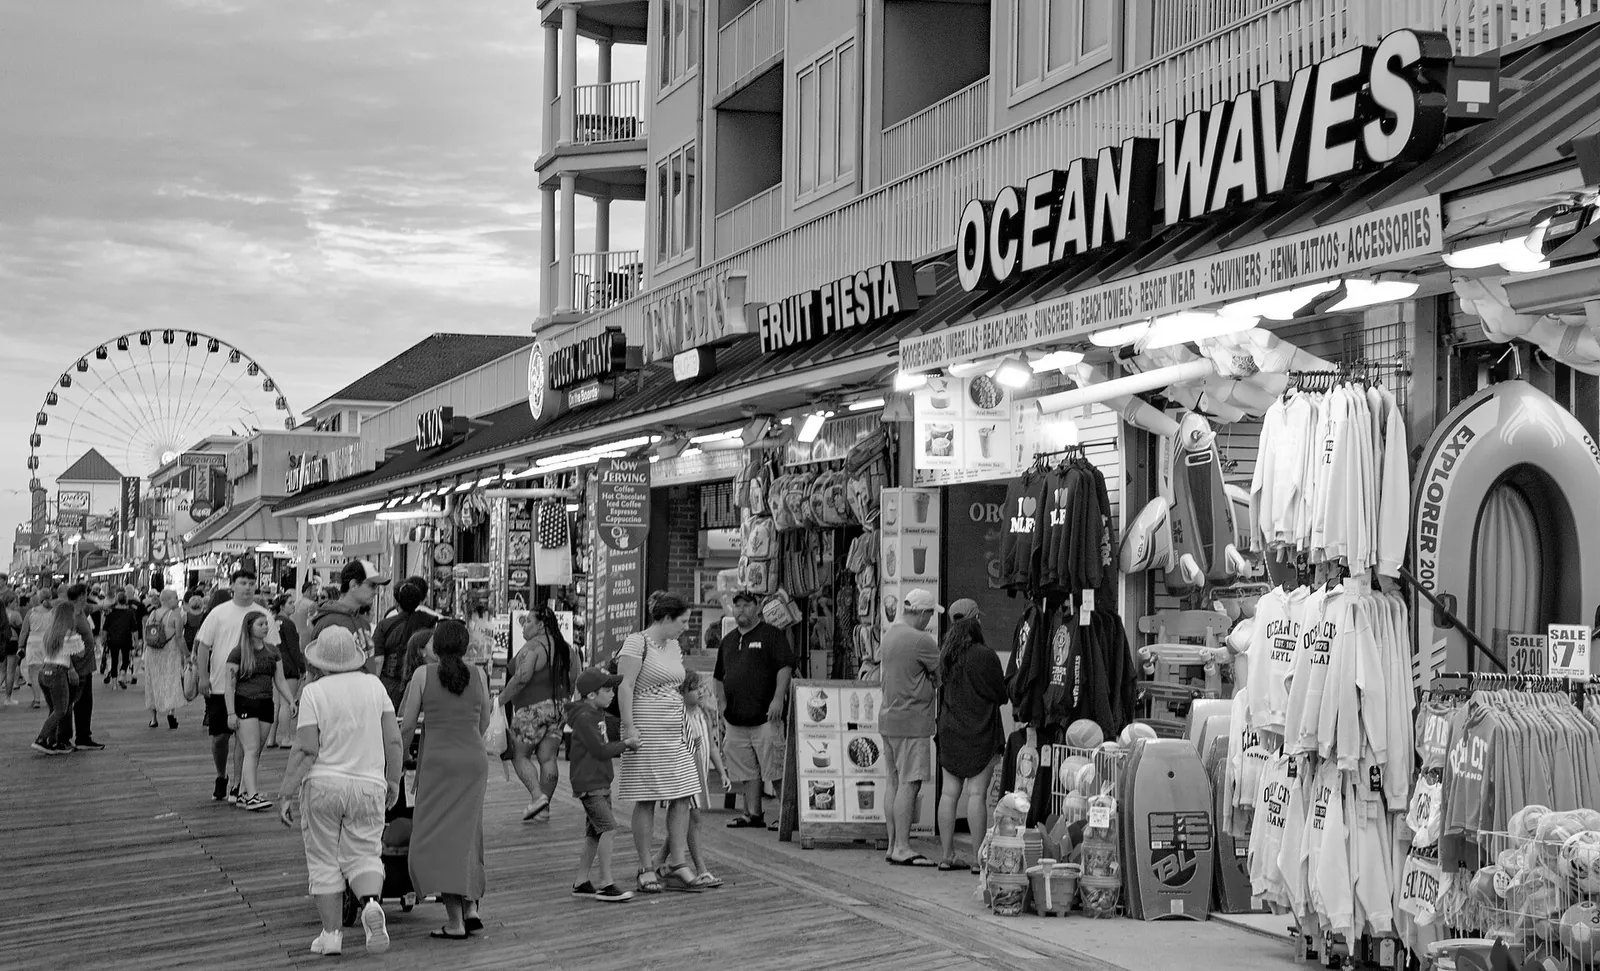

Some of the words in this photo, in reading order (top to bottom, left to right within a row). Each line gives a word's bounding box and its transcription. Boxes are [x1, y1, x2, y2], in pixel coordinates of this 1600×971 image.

[956, 137, 1133, 292] OCEAN
[1164, 28, 1421, 226] WAVES
[945, 327, 979, 360] UMBRELLAS
[983, 320, 1004, 351] BEACH
[1005, 313, 1028, 345] CHAIRS
[1034, 301, 1074, 338] SUNSCREEN
[1080, 294, 1101, 326] BEACH
[1103, 284, 1133, 320] TOWELS
[1140, 276, 1167, 312] RESORT
[1170, 269, 1196, 304] WEAR
[1210, 252, 1261, 295] SOUVINIERS
[1270, 242, 1298, 283] HENNA
[1301, 231, 1339, 273] TATTOOS
[1347, 207, 1431, 264] ACCESSORIES
[758, 290, 812, 353] FRUIT
[821, 261, 900, 335] FIESTA
[613, 485, 635, 493] Coffee
[1420, 425, 1476, 554] EXPLORER
[602, 492, 614, 500] Hot
[615, 492, 646, 501] Chocolate
[606, 500, 619, 508] Iced
[620, 500, 641, 508] Coffee
[610, 508, 638, 516] Espresso
[605, 515, 642, 524] Cappuccino
[1420, 558, 1435, 590] 200
[614, 579, 631, 588] FRIED
[612, 585, 635, 596] PICKLES
[607, 603, 624, 613] FRIED
[625, 601, 638, 609] MAC
[615, 609, 637, 619] CHEESE
[1550, 630, 1586, 640] SALE
[1509, 637, 1543, 648] SALE
